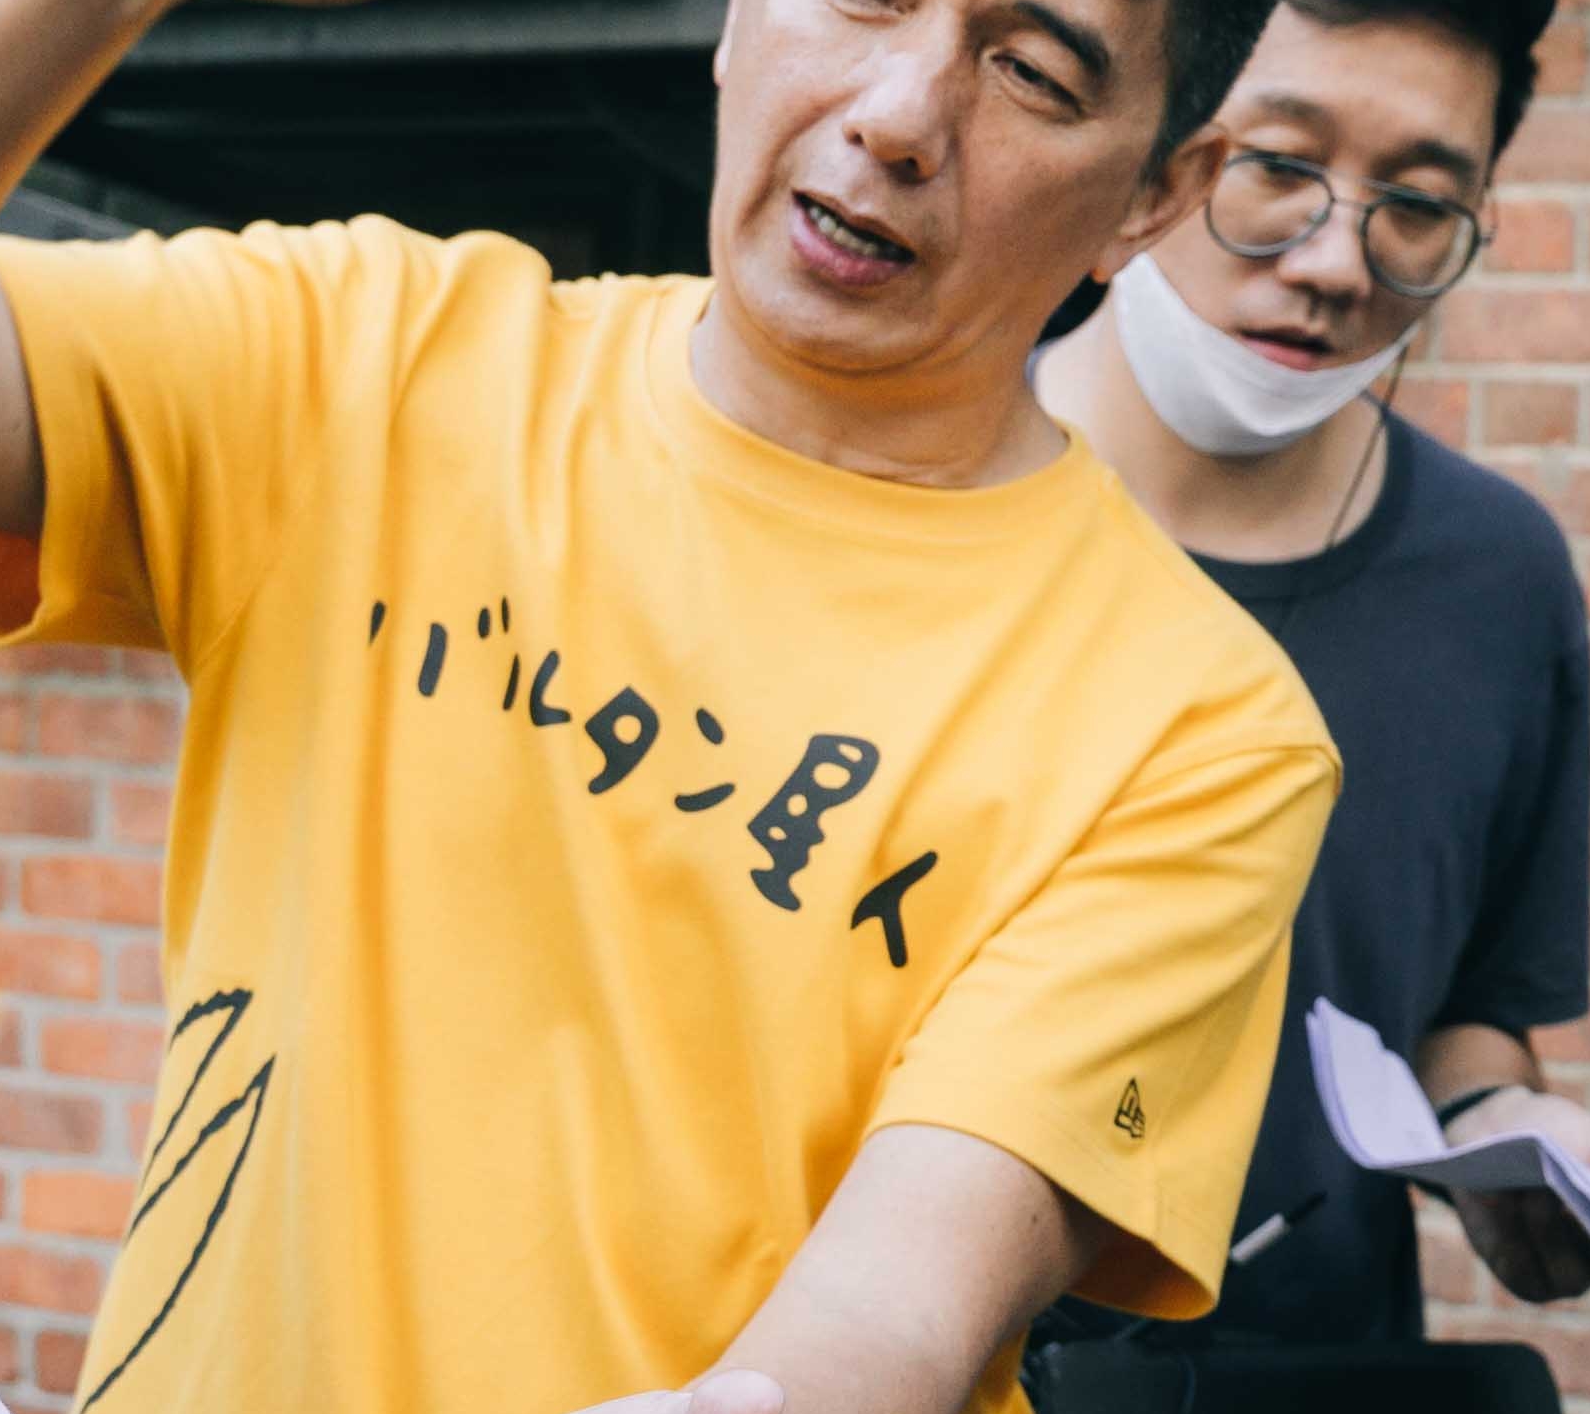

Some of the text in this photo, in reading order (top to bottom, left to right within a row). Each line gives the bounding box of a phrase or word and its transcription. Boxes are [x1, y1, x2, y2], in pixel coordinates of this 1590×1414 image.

[368, 596, 940, 970] バルタン星人
